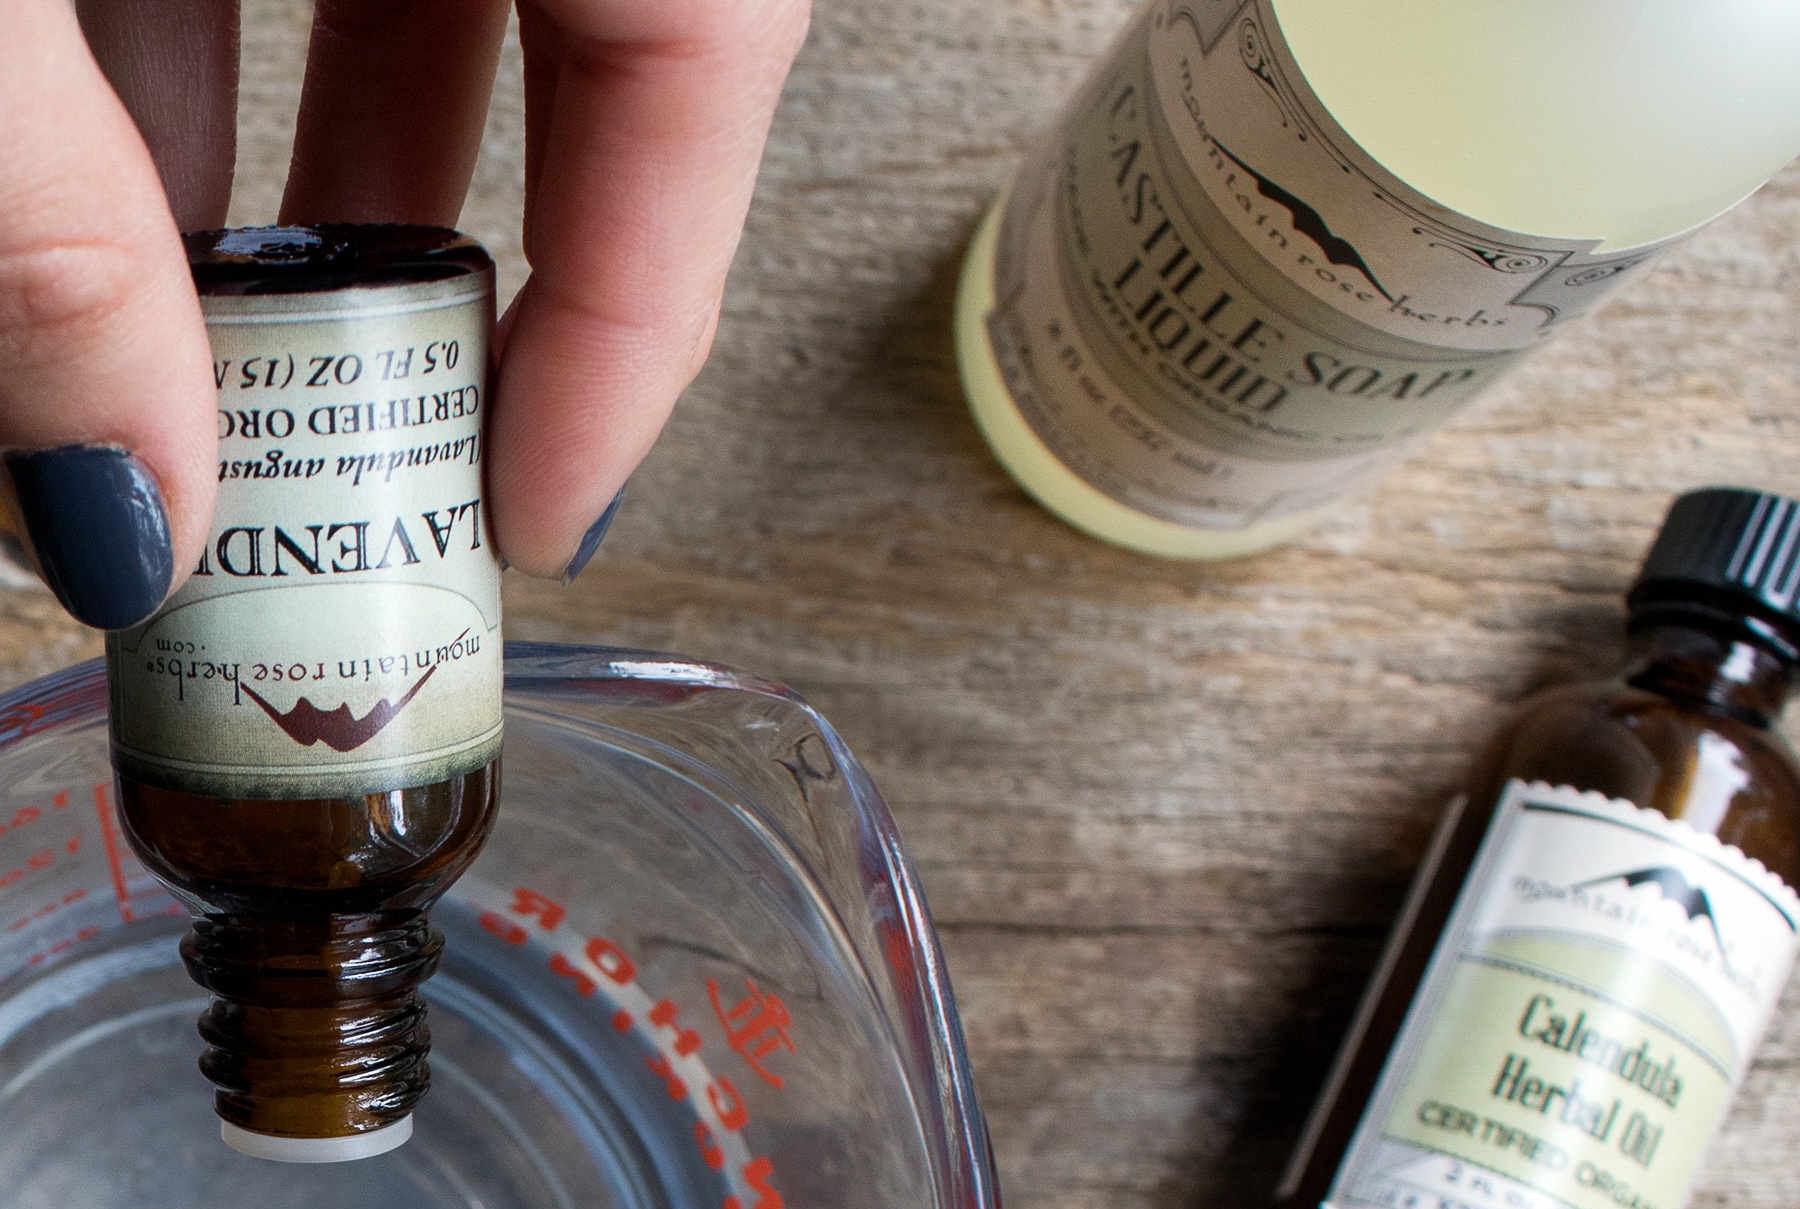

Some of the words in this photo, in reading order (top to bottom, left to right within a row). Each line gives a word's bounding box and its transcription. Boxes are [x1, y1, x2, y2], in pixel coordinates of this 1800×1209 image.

[1177, 54, 1288, 248] mountain
[1298, 253, 1374, 301] rose
[1390, 294, 1507, 327] herbs
[1110, 84, 1285, 364] CASTILLE
[1284, 352, 1475, 400] SOAP
[423, 340, 459, 375] 0.5
[1114, 257, 1289, 412] LIQUID
[240, 353, 295, 389] (15
[305, 355, 363, 387] OZ
[375, 347, 415, 380] FL
[308, 385, 481, 435] CERTIFIED
[336, 436, 481, 487] (Lavandula
[253, 662, 326, 682] rose
[338, 635, 481, 682] mountain
[1518, 994, 1685, 1110] Calendula
[1417, 1101, 1569, 1171] CERTIFIED
[1490, 1052, 1622, 1143] Herbal
[1618, 1109, 1664, 1170] Oil
